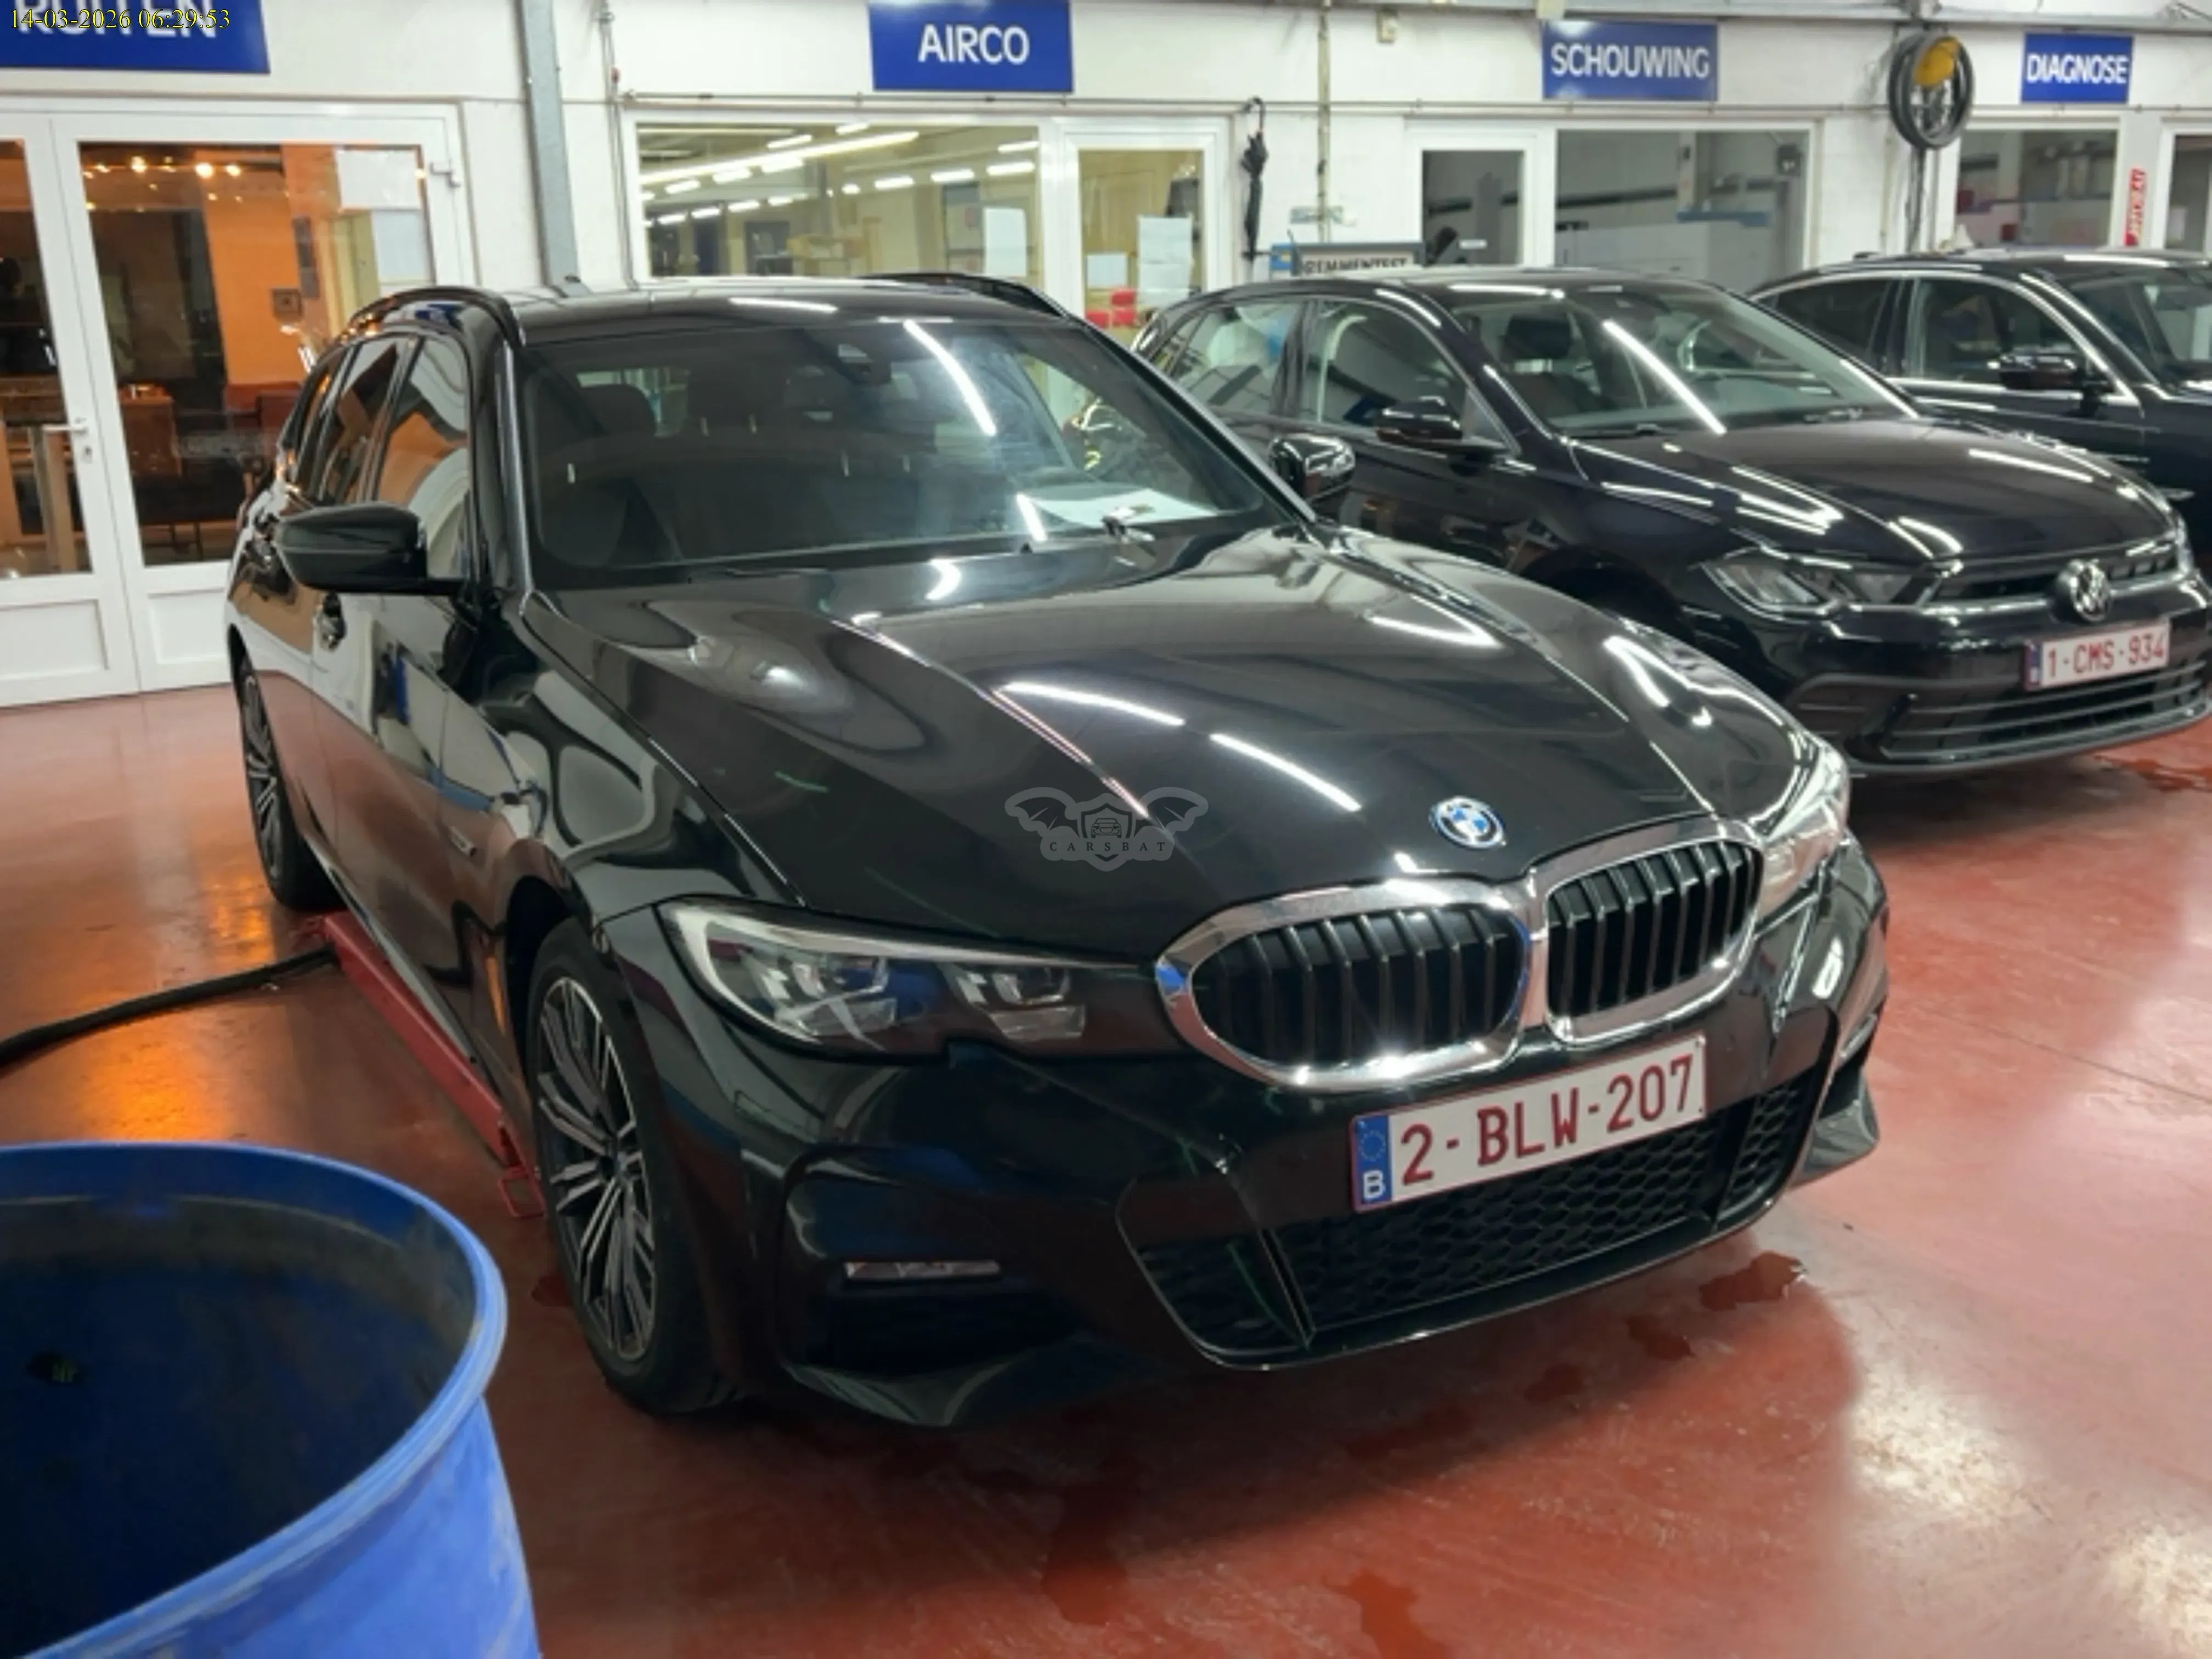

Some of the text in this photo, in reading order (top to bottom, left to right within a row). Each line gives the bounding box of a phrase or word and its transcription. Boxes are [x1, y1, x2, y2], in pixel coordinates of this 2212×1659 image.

[917, 24, 1030, 65] AIRCO
[1550, 42, 1710, 79] SCHOUWING
[2027, 53, 2129, 84] DIAGNOSE
[1400, 1053, 1693, 1186] 2-BLW-207
[1362, 1170, 1387, 1200] B
